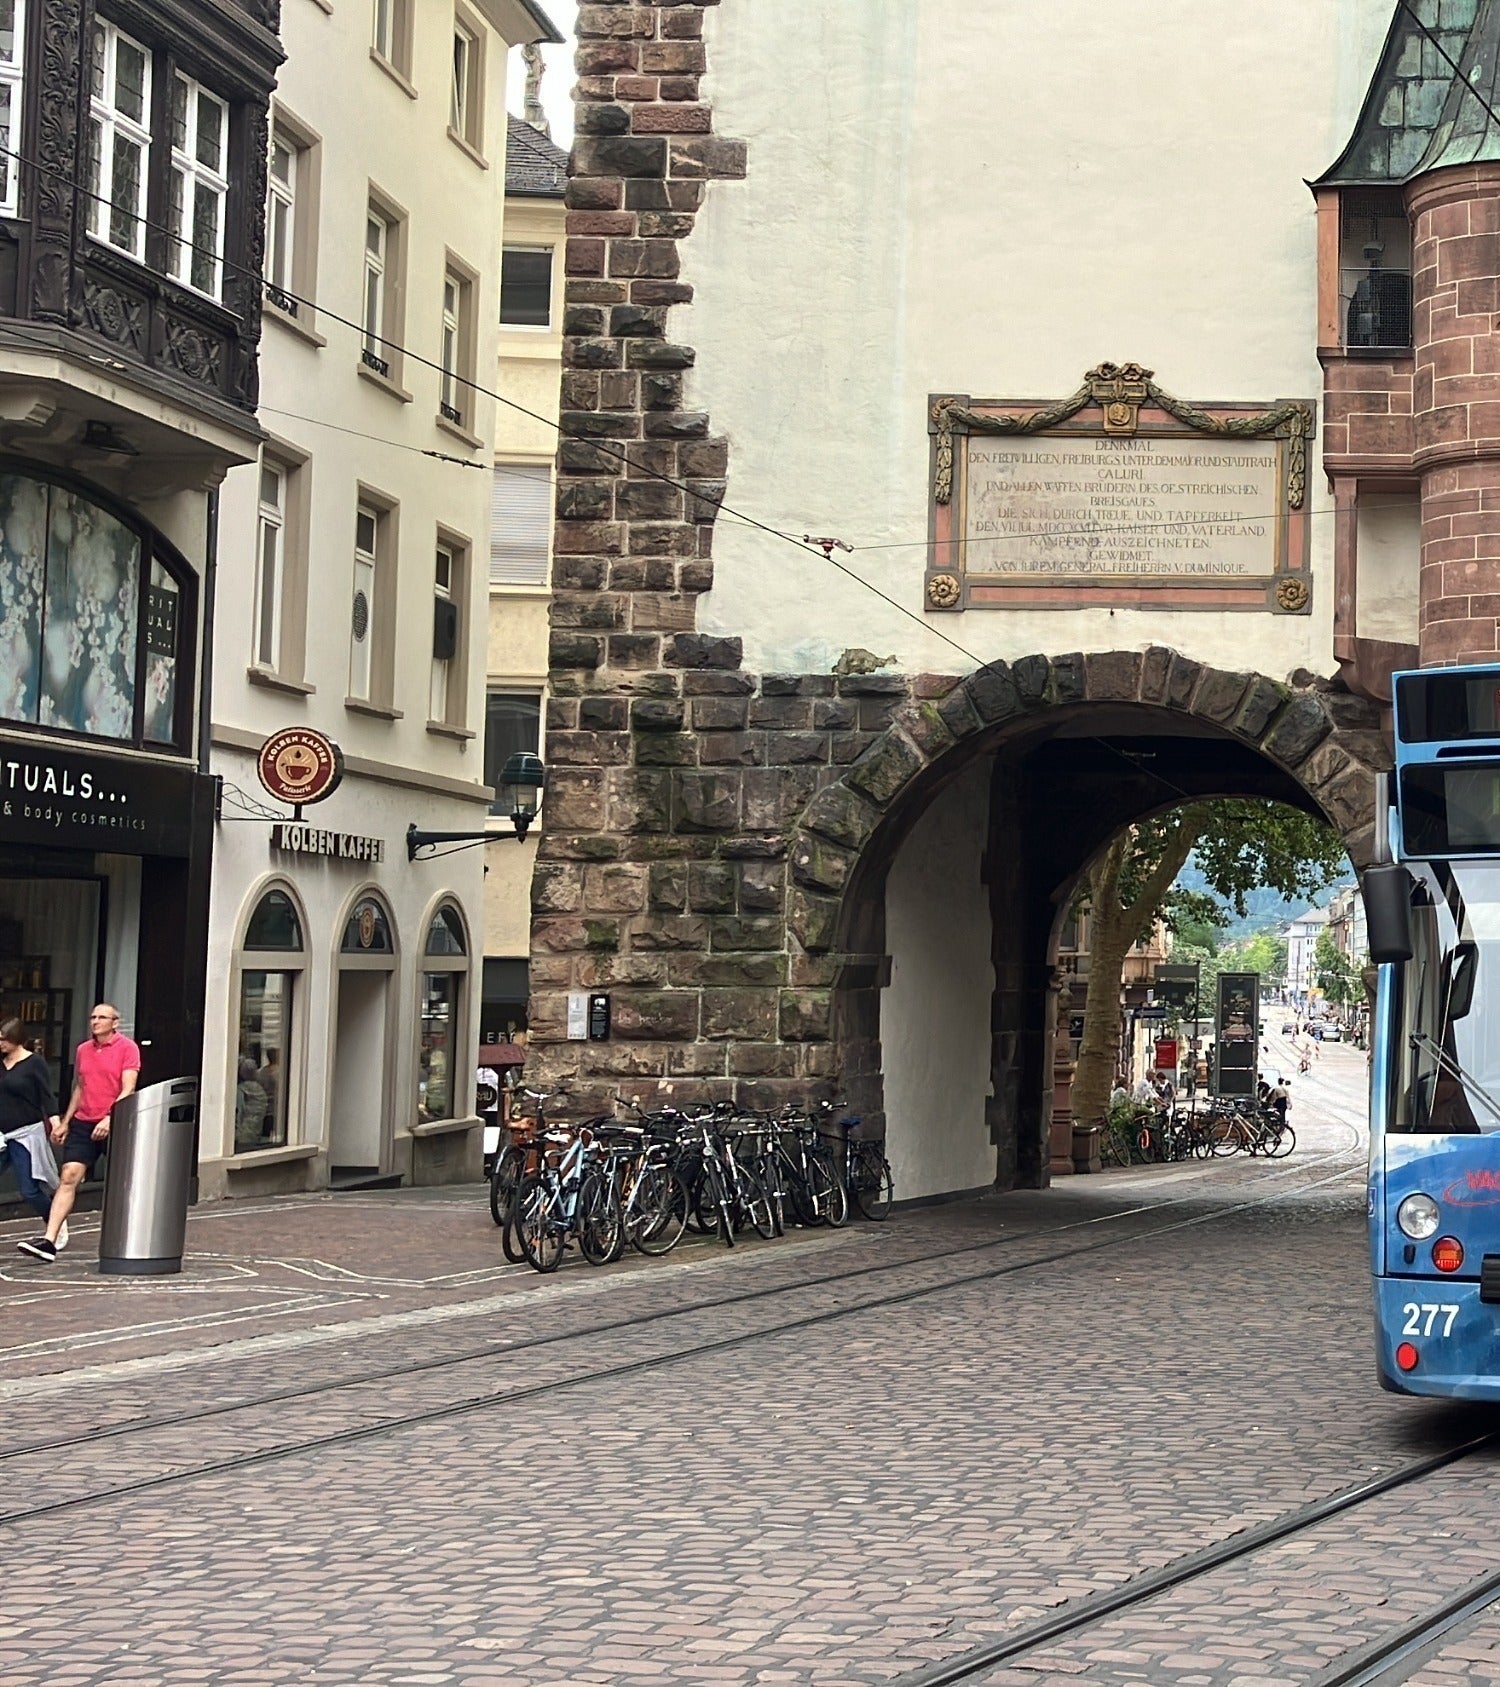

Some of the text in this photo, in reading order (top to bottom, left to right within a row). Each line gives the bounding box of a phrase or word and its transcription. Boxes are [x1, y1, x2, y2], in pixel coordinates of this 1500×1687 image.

[968, 453, 990, 464] DEN
[1095, 440, 1155, 452] DENKMAL
[267, 735, 328, 763] KOLBEN KAFFEE
[0, 758, 126, 803] TUALS...
[24, 803, 63, 827] body
[72, 811, 146, 830] cosmetics
[281, 824, 335, 856] KOLBEN
[1402, 1302, 1460, 1337] 277
